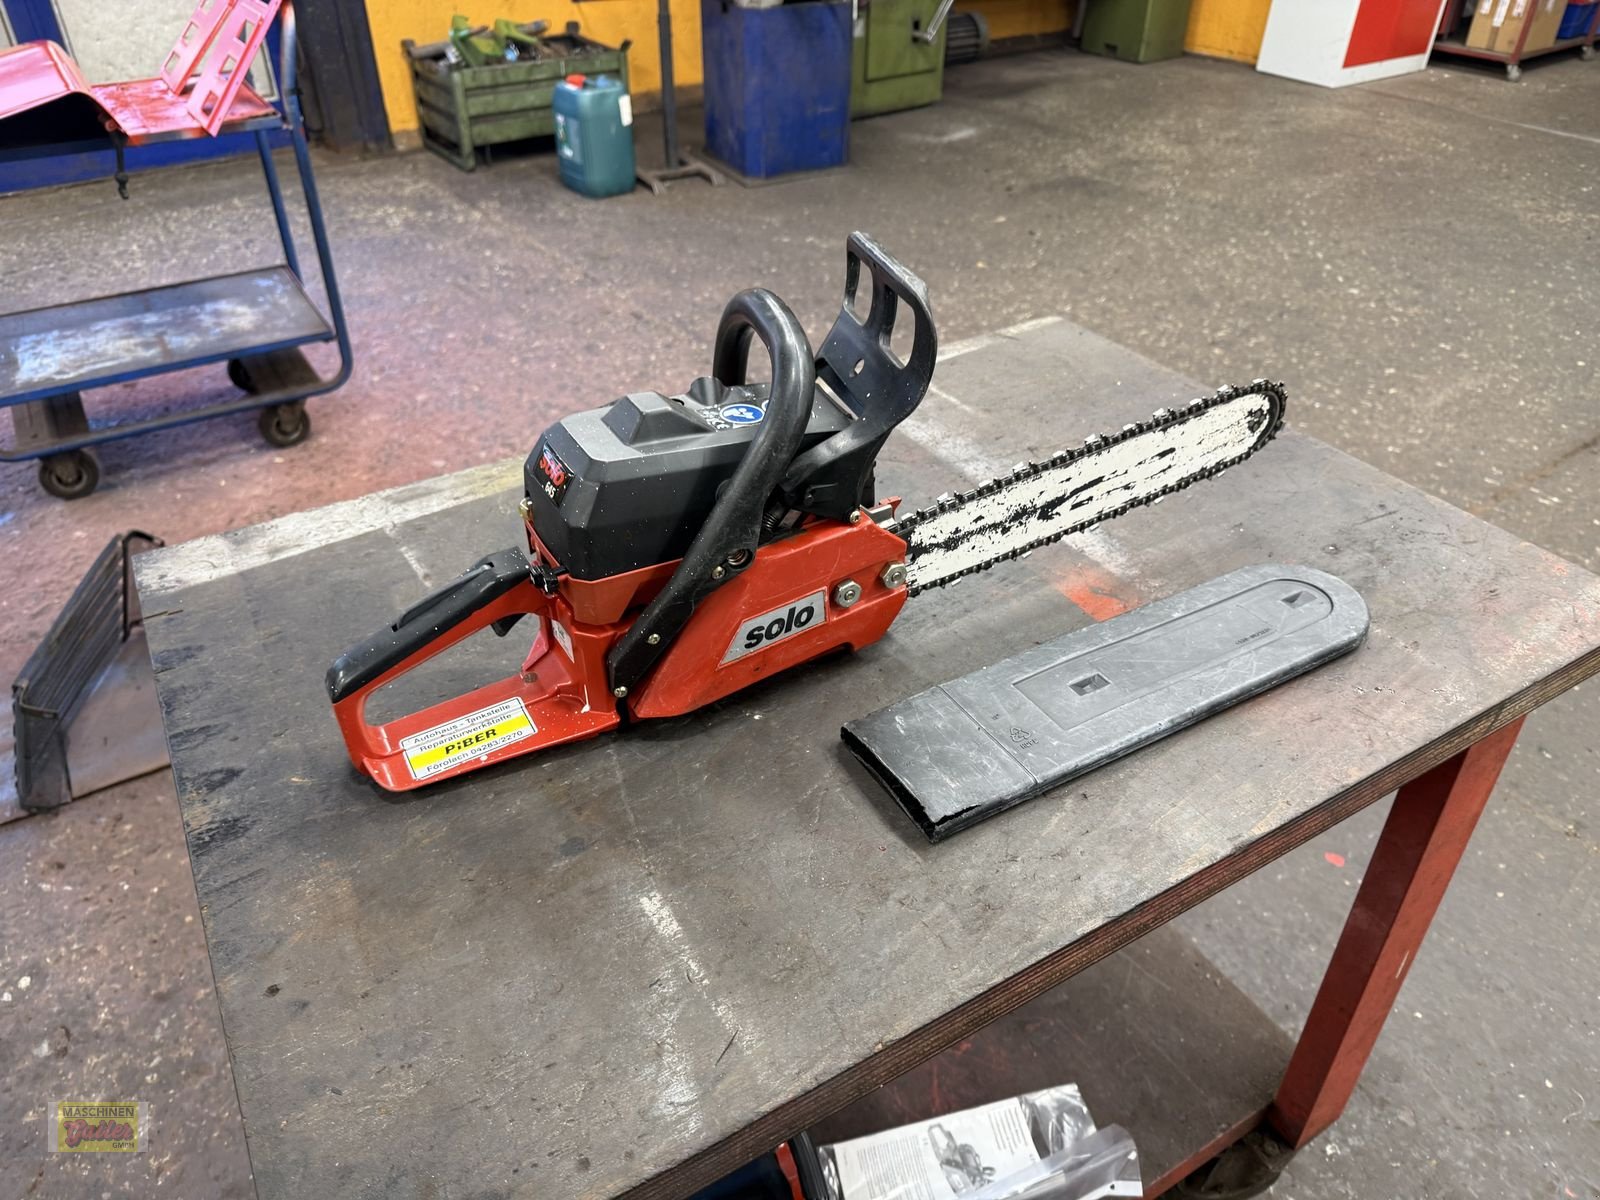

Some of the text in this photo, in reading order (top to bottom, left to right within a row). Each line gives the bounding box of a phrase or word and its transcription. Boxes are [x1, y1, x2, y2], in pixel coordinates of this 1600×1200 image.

[744, 606, 814, 649] solo
[414, 724, 458, 743] Autohaus
[466, 704, 511, 724] Tankstelle
[470, 730, 523, 755] 04283/2270
